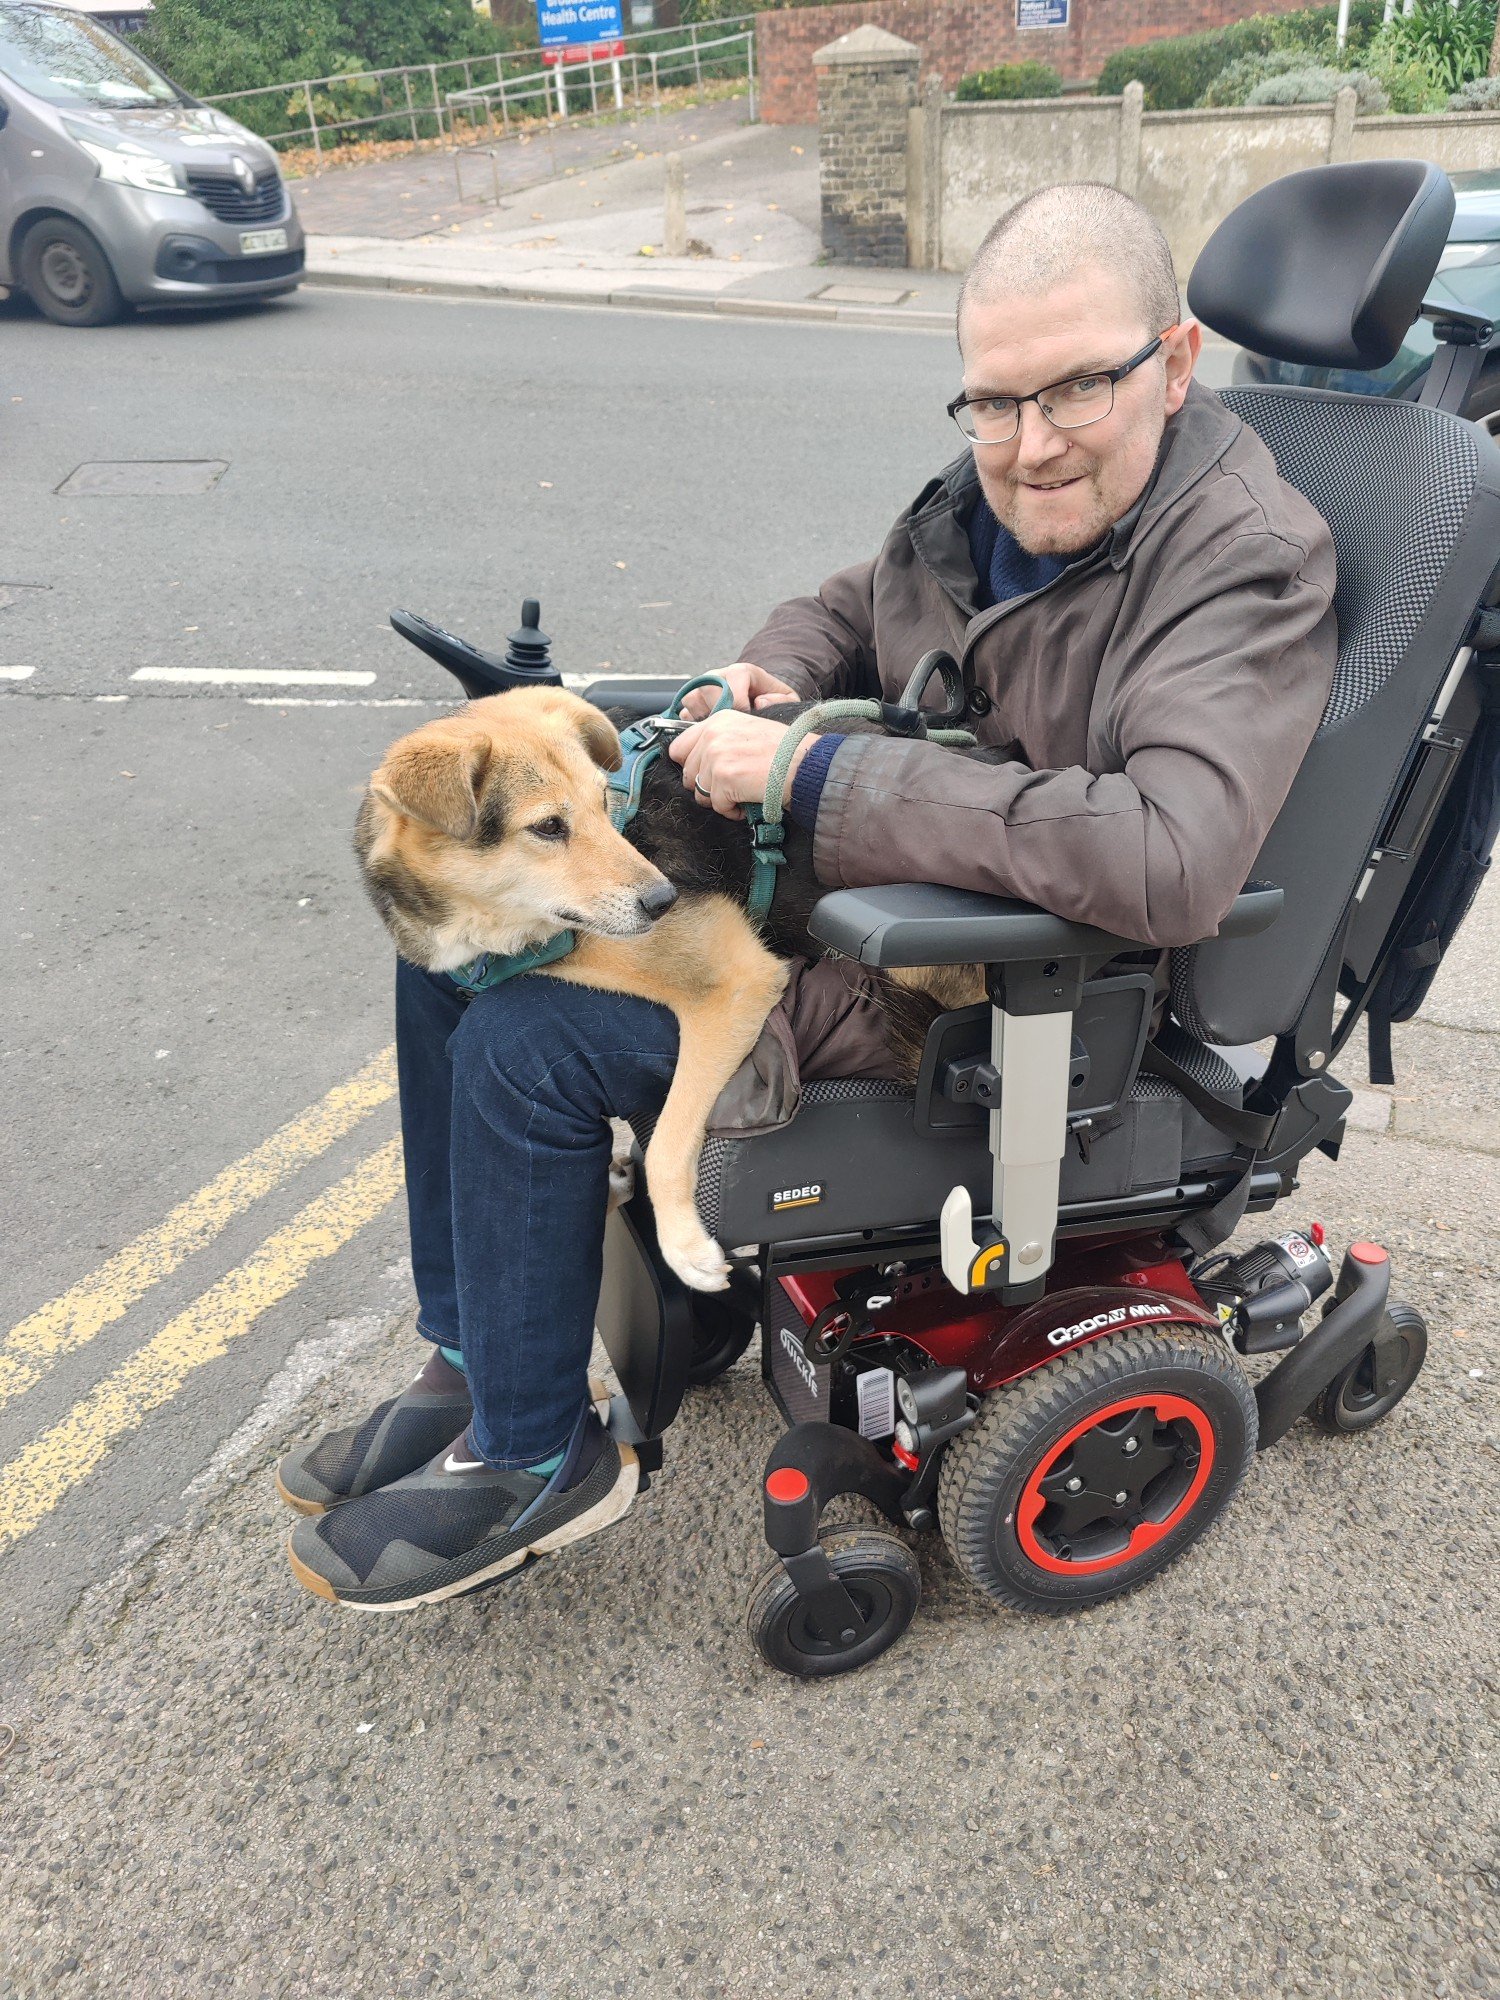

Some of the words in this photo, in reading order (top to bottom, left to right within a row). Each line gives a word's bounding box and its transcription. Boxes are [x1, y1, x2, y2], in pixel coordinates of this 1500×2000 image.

[541, 7, 578, 26] Health
[578, 5, 616, 22] Centre
[773, 1185, 821, 1202] SEDEO
[1129, 1303, 1172, 1318] Mini
[780, 1328, 818, 1398] QUICKIE
